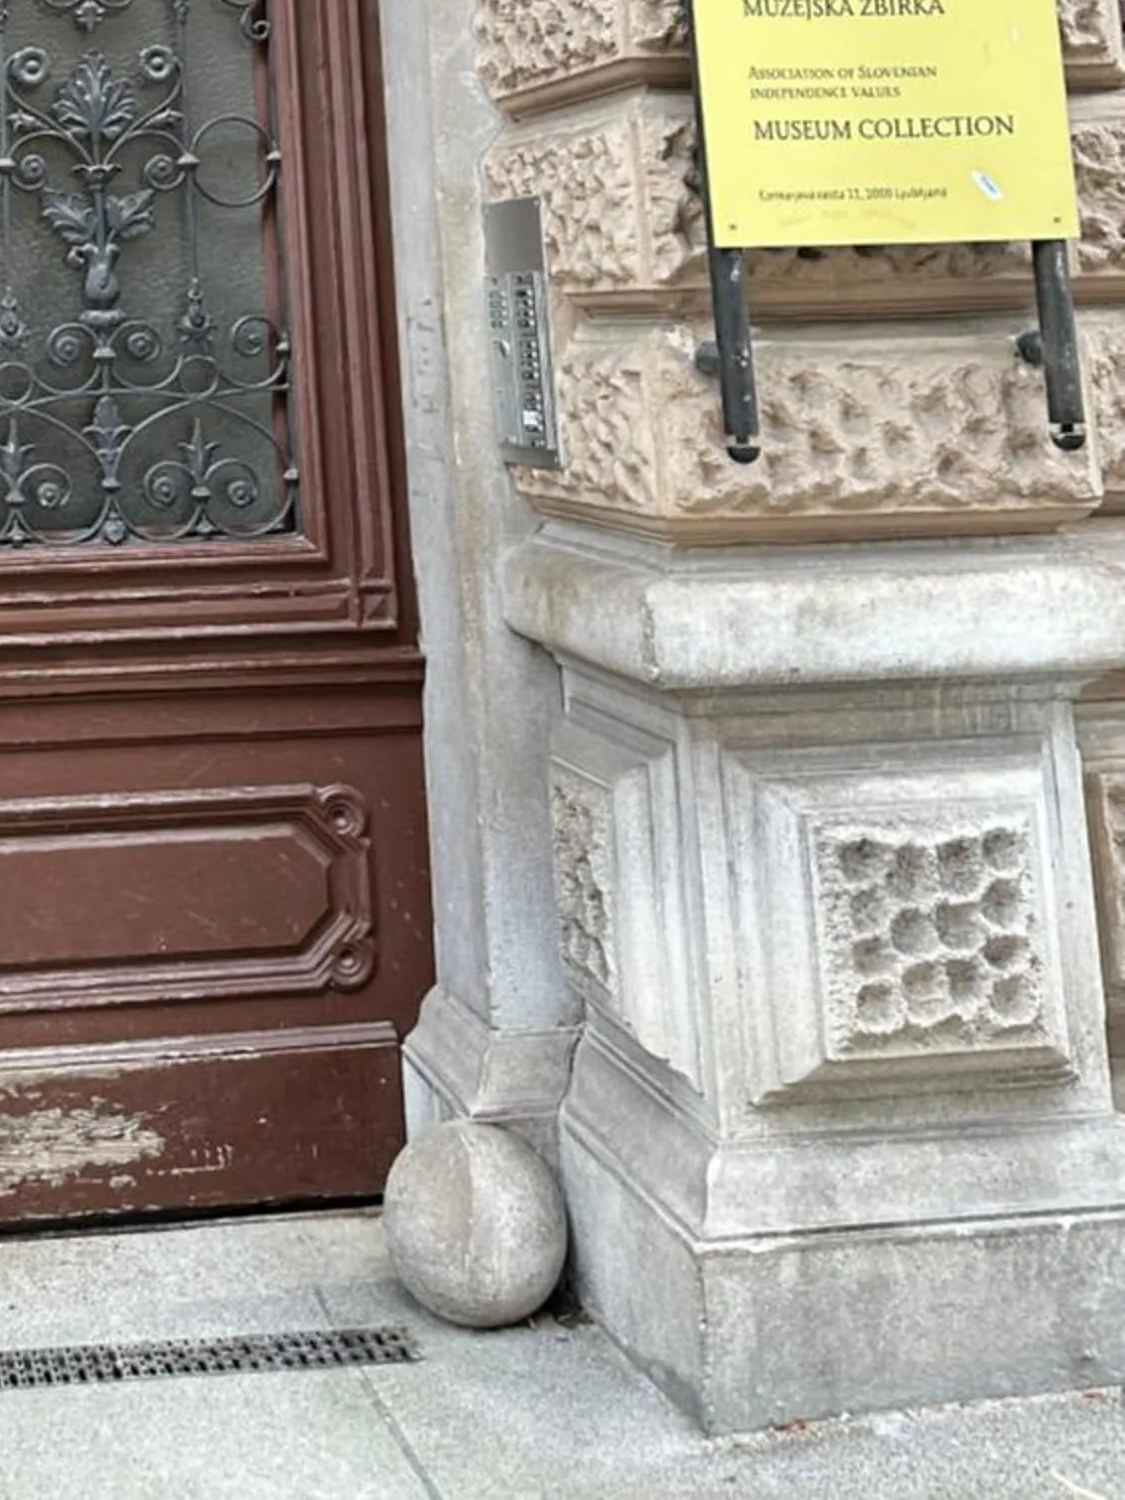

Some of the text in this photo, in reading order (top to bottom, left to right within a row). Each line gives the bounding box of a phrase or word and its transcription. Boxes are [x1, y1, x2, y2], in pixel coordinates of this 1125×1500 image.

[748, 65, 937, 80] ASSOCIATION OF SLOVENIAN
[750, 86, 901, 99] INDEPENDENCE VALUES
[753, 115, 1015, 141] MUSEUM COLLECTION
